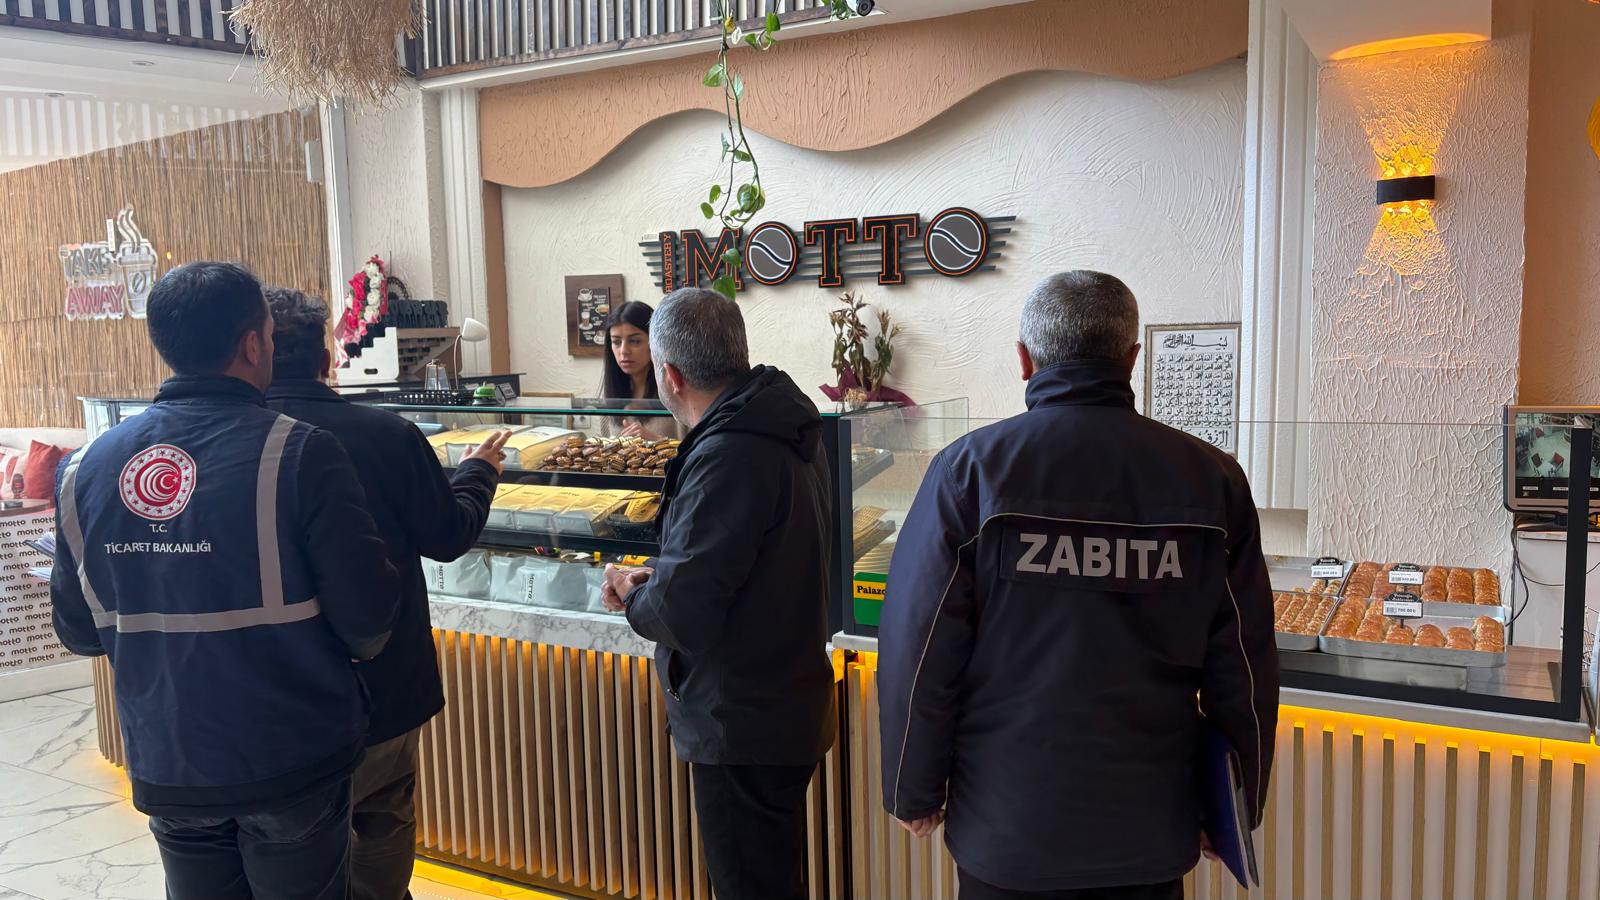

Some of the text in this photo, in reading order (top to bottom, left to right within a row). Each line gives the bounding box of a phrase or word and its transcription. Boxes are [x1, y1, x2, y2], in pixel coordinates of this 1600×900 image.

[680, 207, 990, 292] MOTTO
[60, 244, 112, 277] TAKE
[66, 285, 124, 314] AWAY
[17, 528, 43, 536] motto
[149, 523, 168, 533] T.C.
[104, 540, 211, 554] TİCARET BAKANLIĞI
[19, 549, 41, 557] mott
[1016, 532, 1184, 580] ZABITA
[4, 562, 30, 571] motto
[5, 583, 32, 592] motto
[0, 591, 49, 603] otto motto
[7, 604, 34, 613] motto
[0, 612, 51, 624] otto motto
[9, 625, 36, 634] motto
[27, 632, 53, 642] motto
[11, 646, 38, 655] motto
[29, 653, 55, 663] motto
